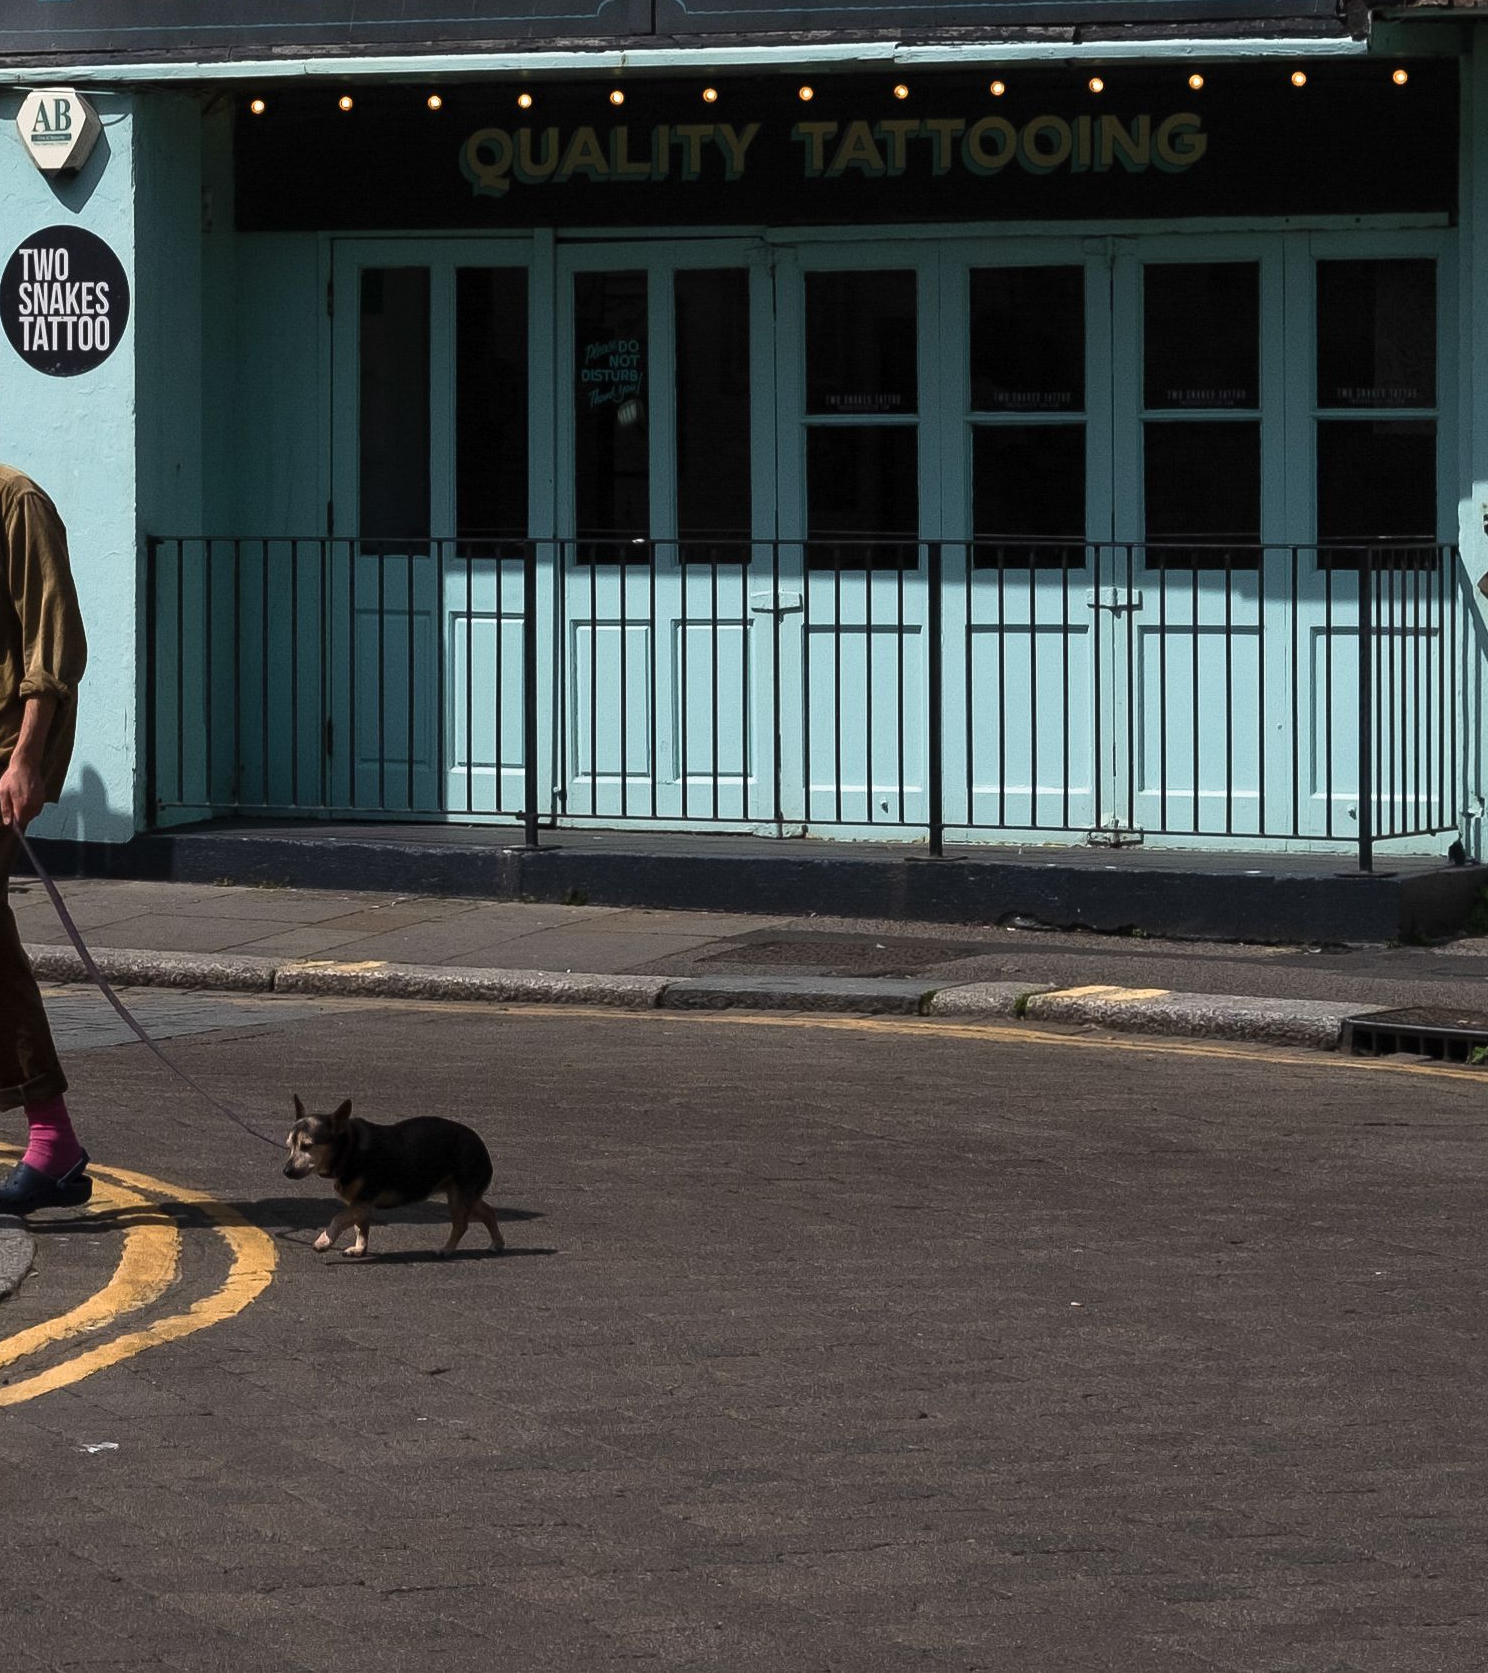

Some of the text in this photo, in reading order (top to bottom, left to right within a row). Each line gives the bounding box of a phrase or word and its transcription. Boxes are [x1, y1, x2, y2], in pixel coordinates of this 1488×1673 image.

[31, 98, 73, 132] AB
[458, 111, 1210, 198] QUALITY TATTOOING
[18, 247, 69, 281] TWO
[17, 281, 110, 315] SNAKES
[18, 315, 111, 352] TATTOO
[618, 338, 640, 353] DO
[609, 353, 641, 367] NOT
